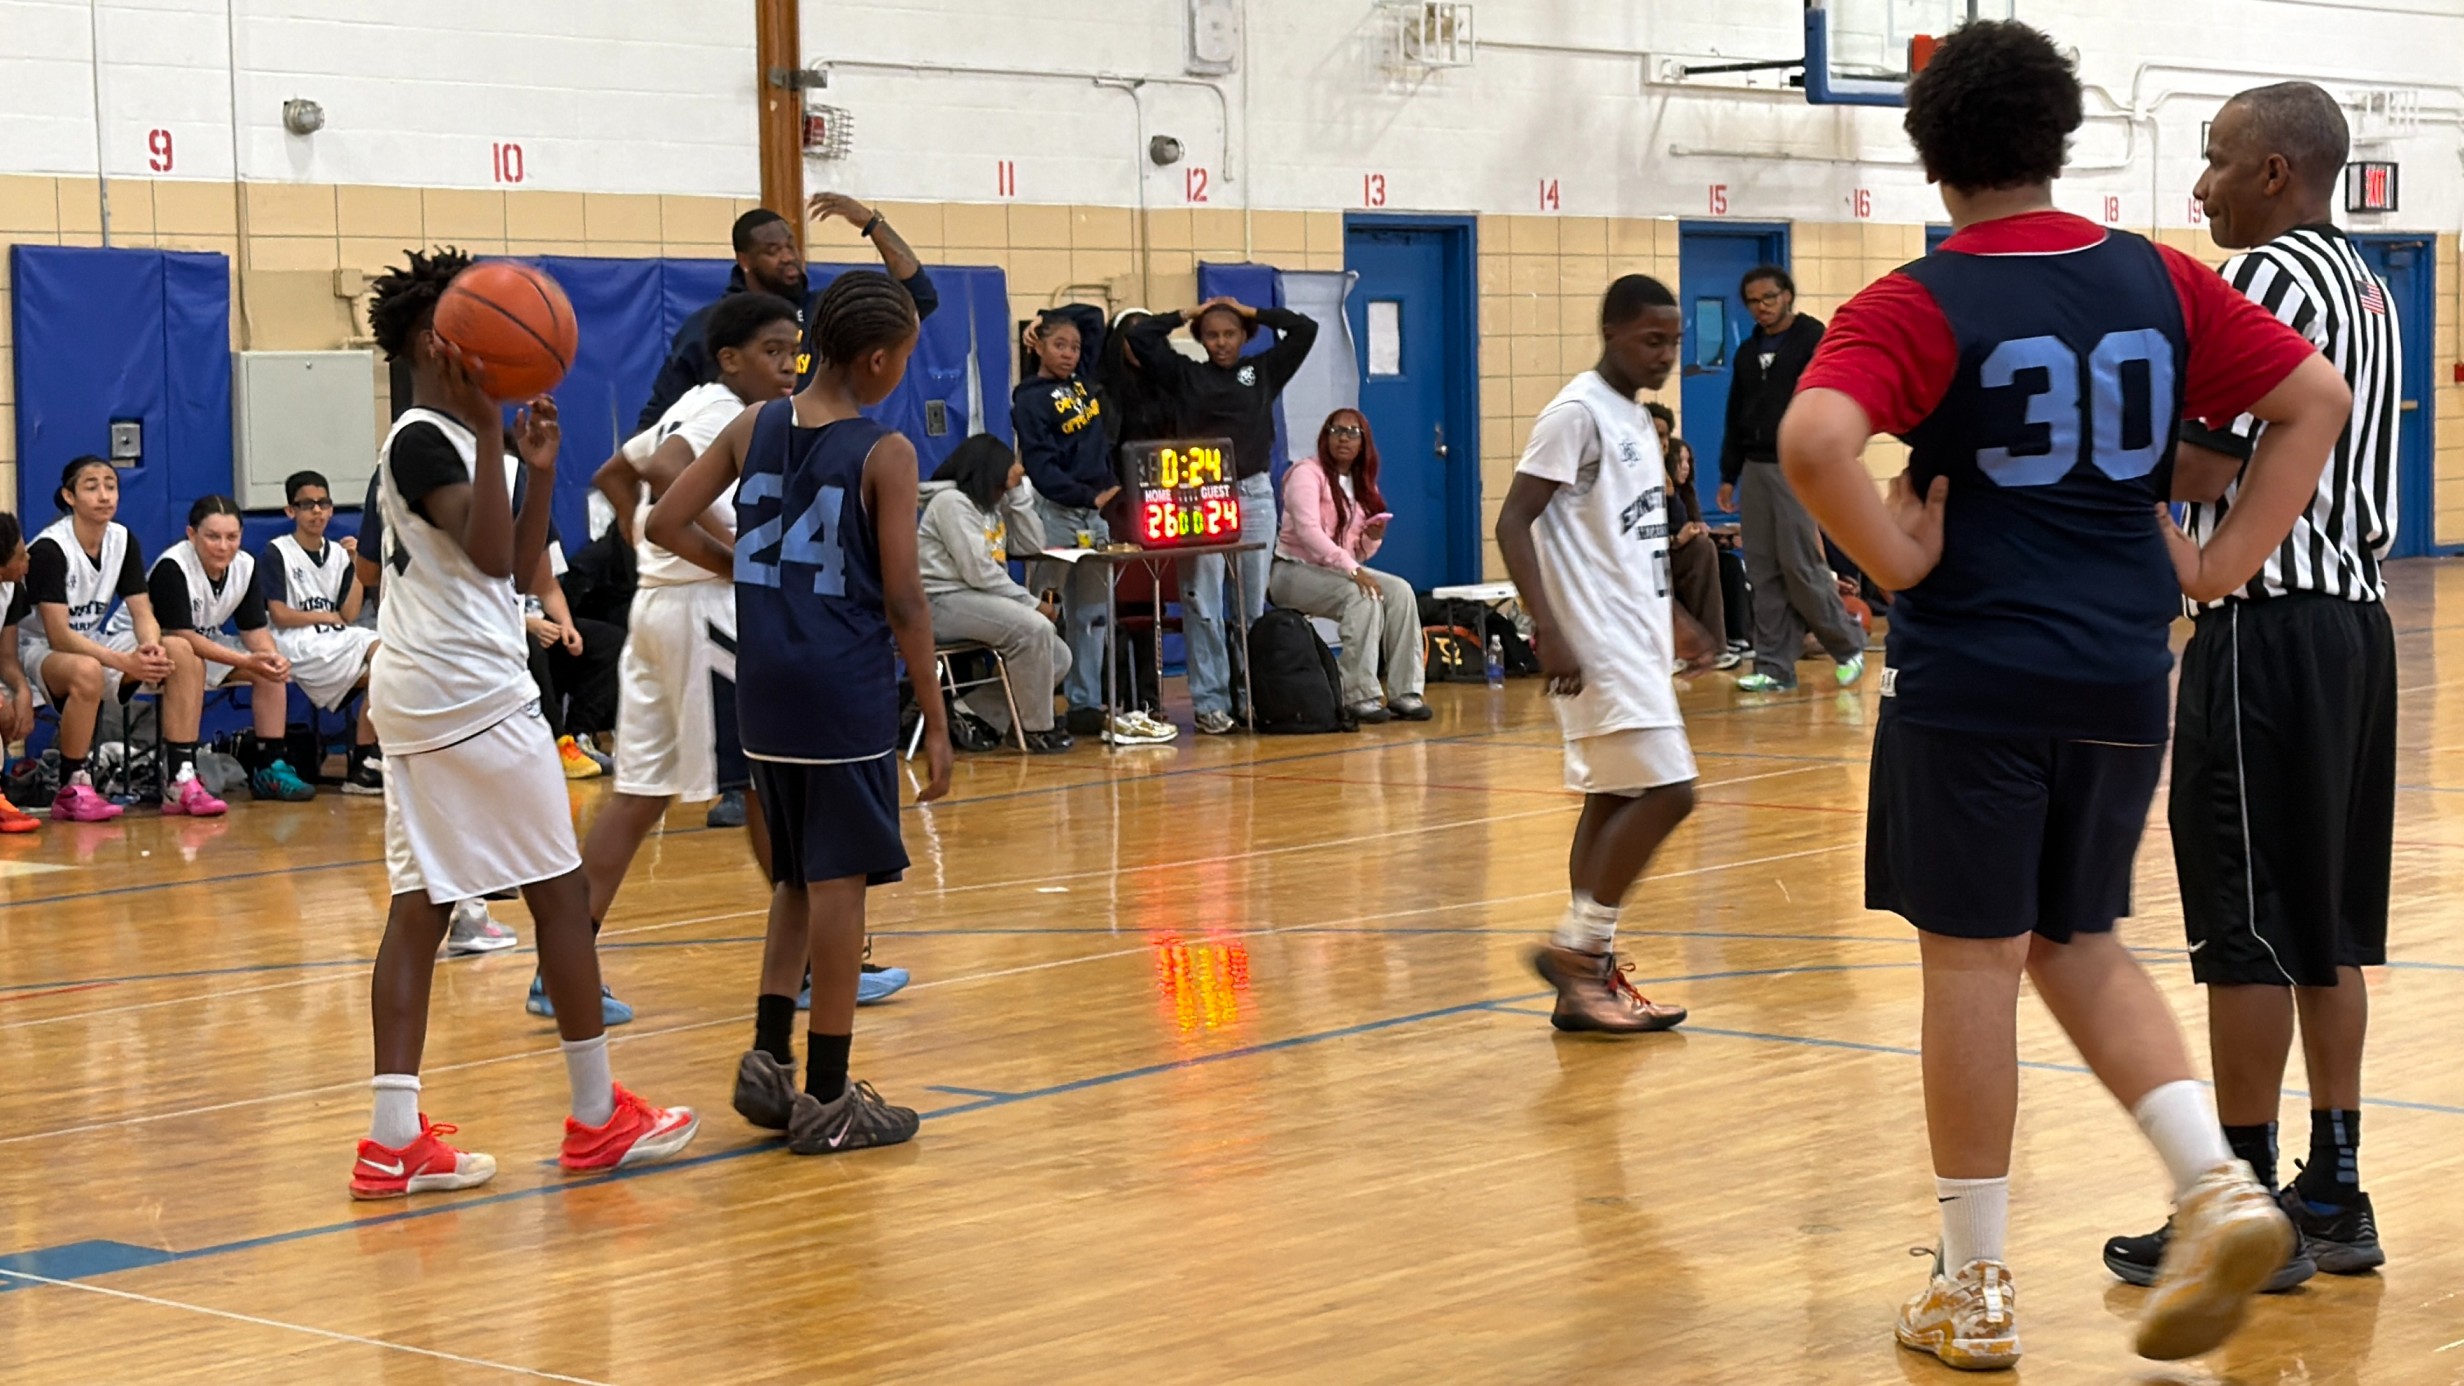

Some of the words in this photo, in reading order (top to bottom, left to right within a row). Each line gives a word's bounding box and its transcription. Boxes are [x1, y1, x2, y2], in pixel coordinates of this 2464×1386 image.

[148, 129, 174, 172] 9
[493, 142, 524, 183] 10
[998, 160, 1015, 197] 11
[1186, 167, 1208, 203] 12
[1364, 174, 1386, 207] 13
[1540, 179, 1560, 210] 14
[1709, 184, 1728, 216] 15
[1854, 189, 1871, 218] 16
[2104, 195, 2119, 222] 18
[2187, 198, 2202, 224] 19
[1976, 327, 2176, 488] 30
[1161, 446, 1221, 488] 0:24
[1144, 489, 1173, 502] HOME
[1200, 484, 1231, 499] GUEST
[732, 472, 847, 597] 24
[1146, 503, 1178, 539] 26
[1203, 499, 1238, 534] 24
